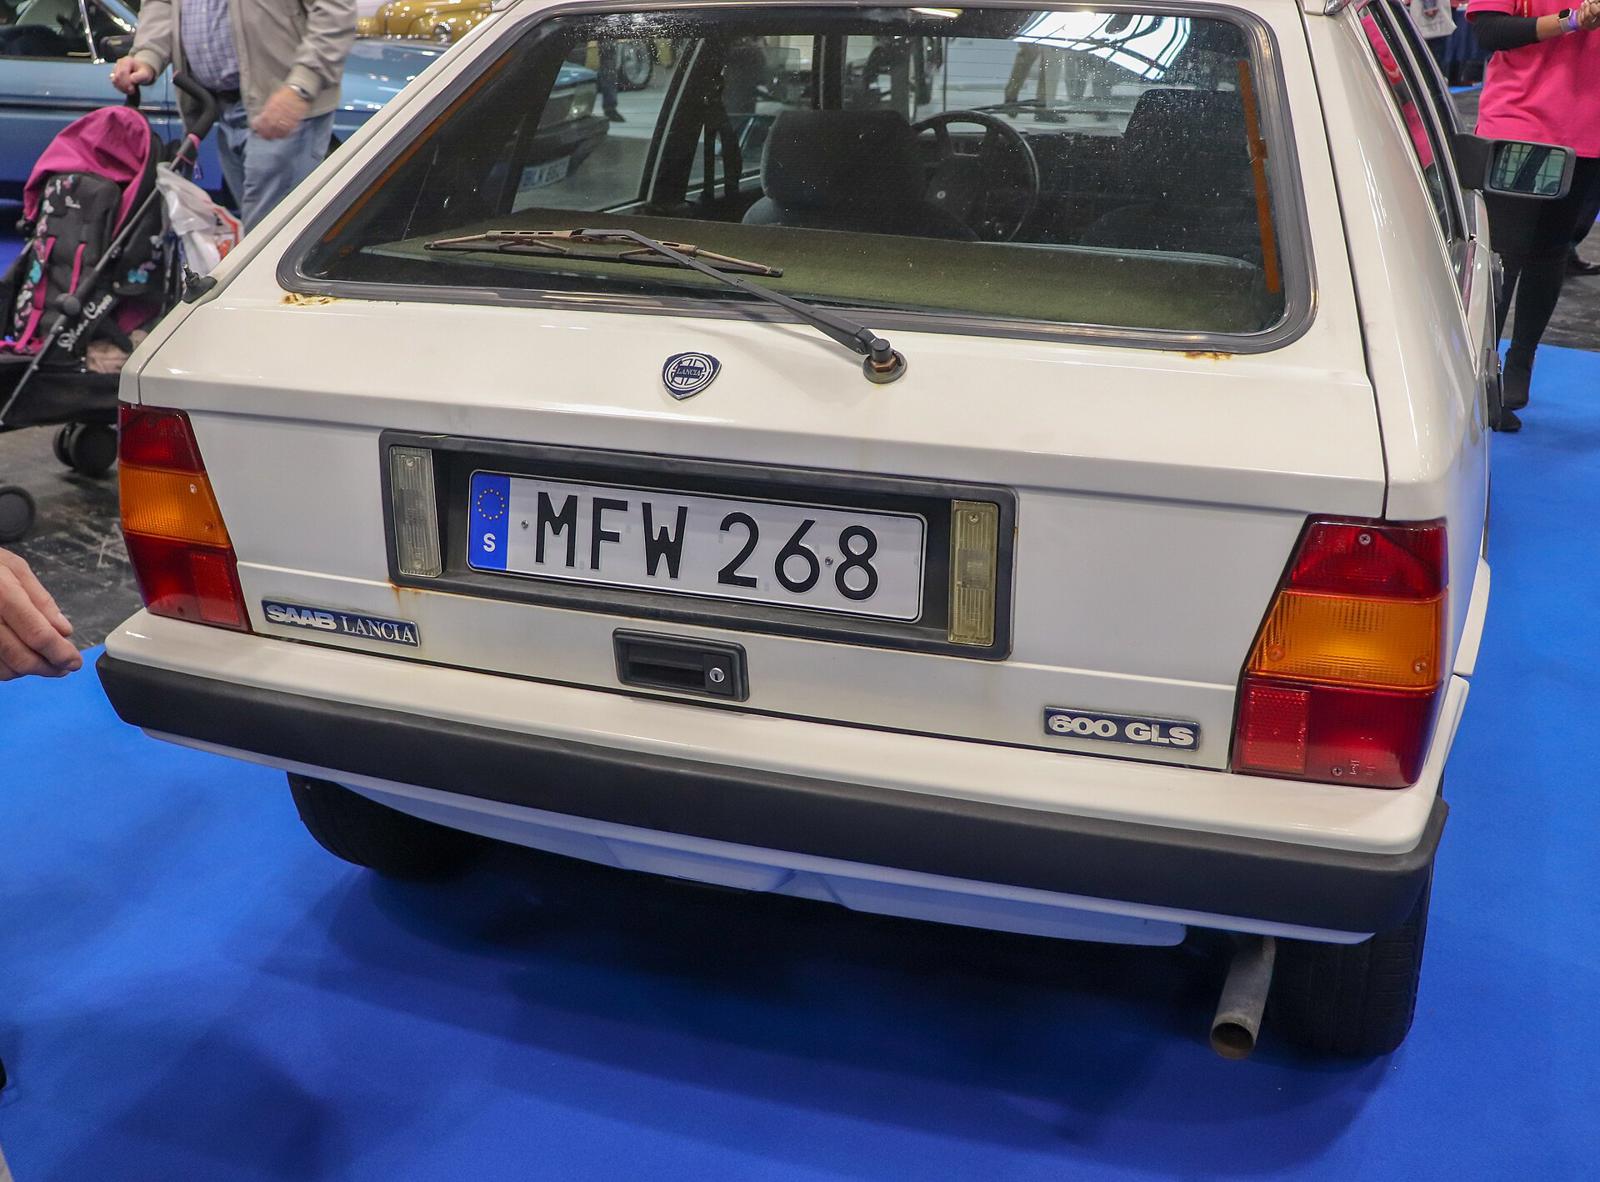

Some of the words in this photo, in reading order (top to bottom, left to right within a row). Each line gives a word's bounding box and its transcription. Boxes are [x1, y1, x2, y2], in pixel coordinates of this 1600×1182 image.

[676, 367, 702, 377] LANCIA
[483, 533, 496, 552] S
[534, 491, 688, 579] MFW
[717, 511, 879, 600] 268
[266, 604, 337, 630] SAAB
[340, 615, 417, 644] LANCIA
[1048, 714, 1118, 737] 600
[1125, 722, 1194, 745] GLS
